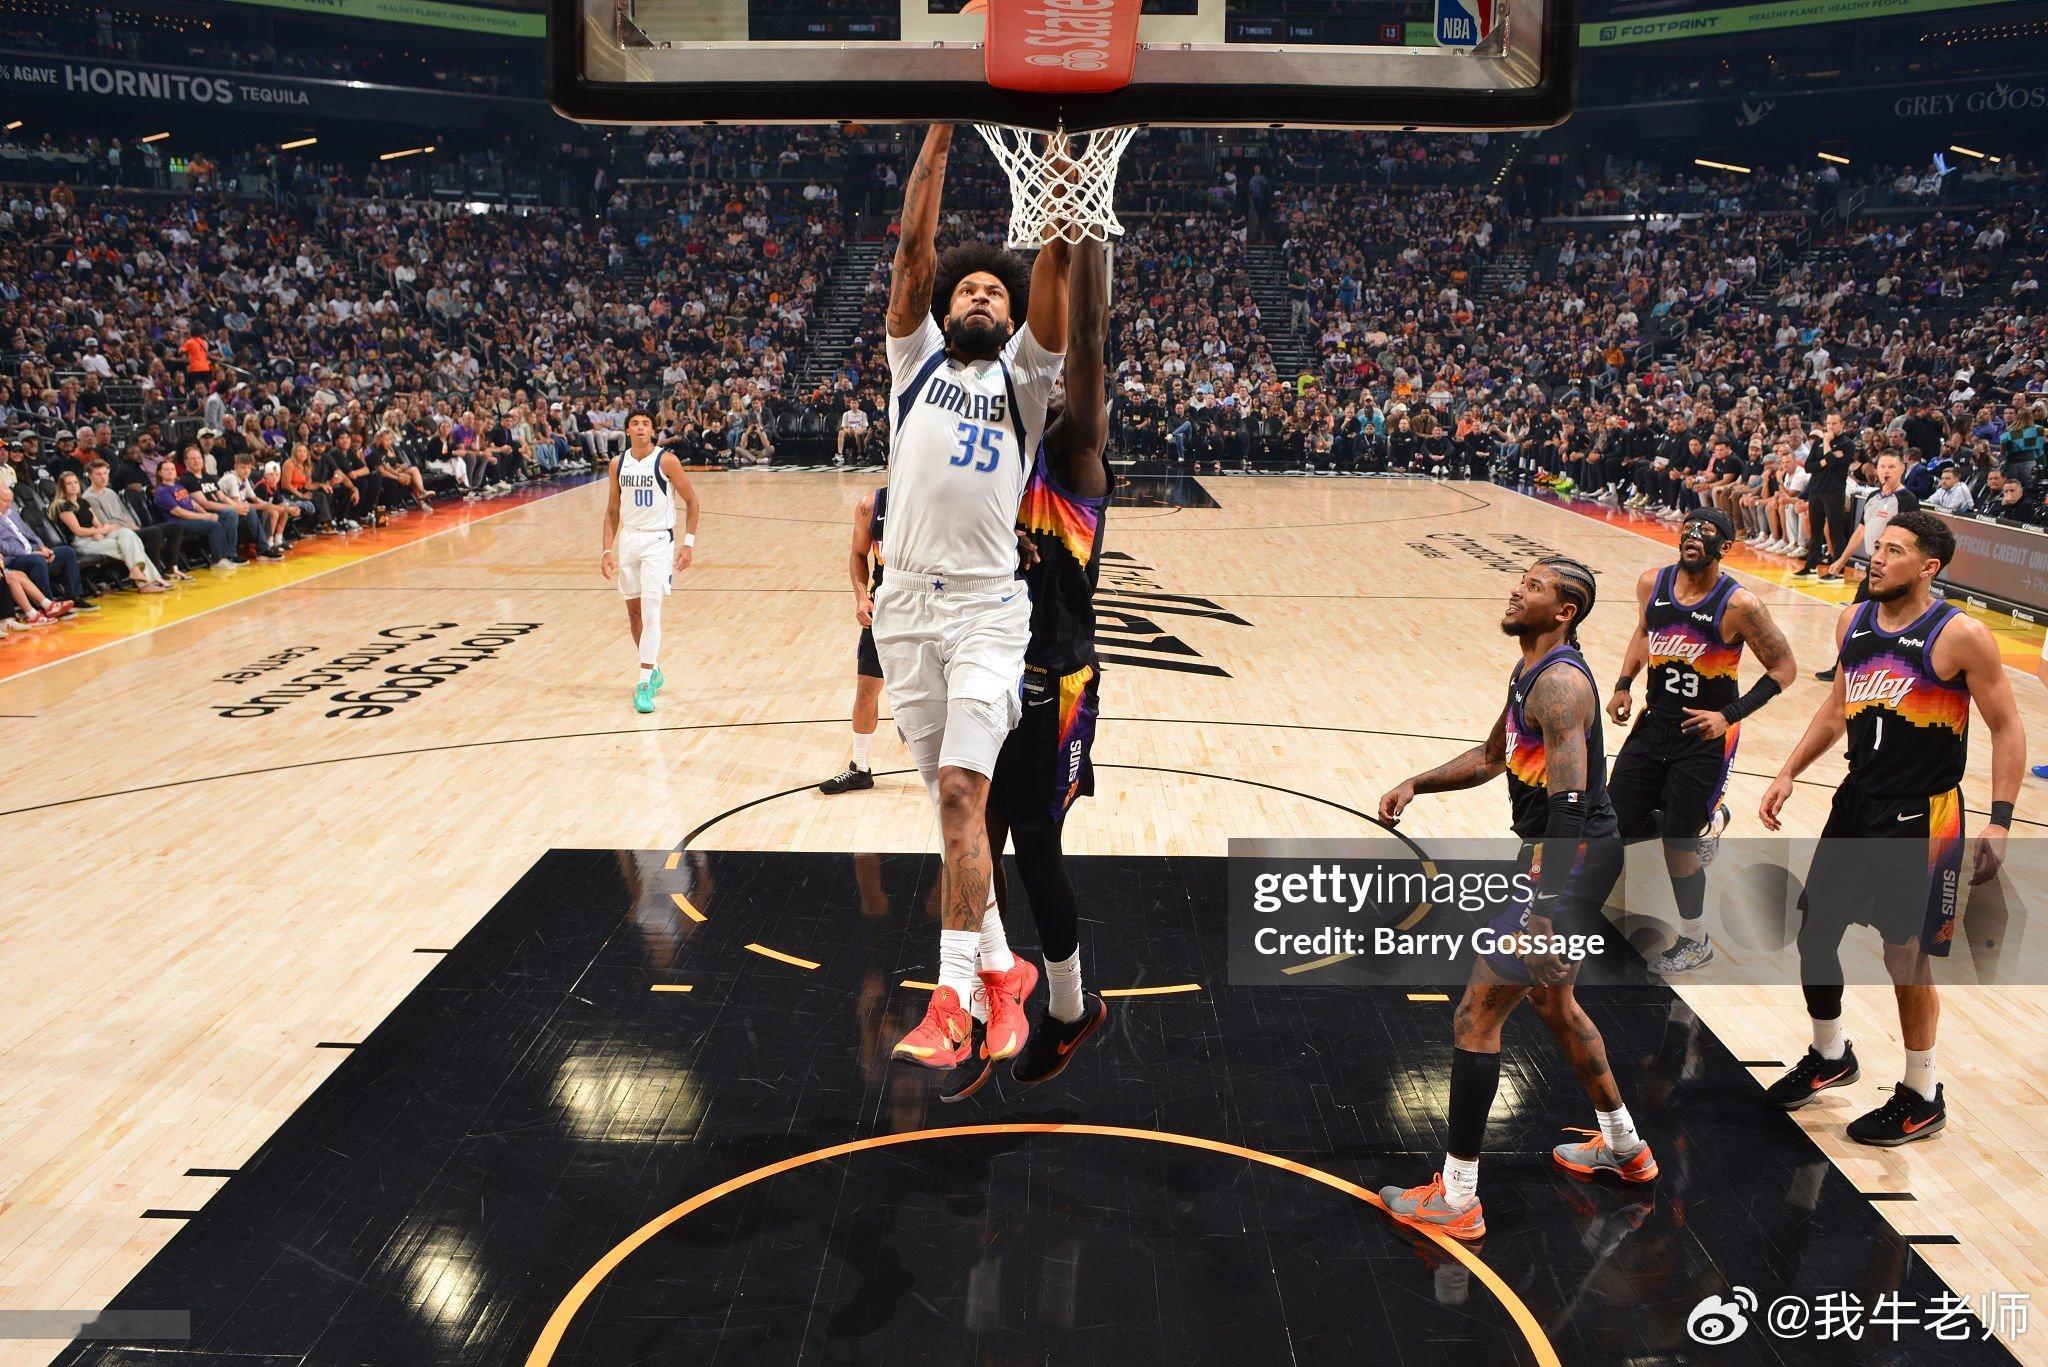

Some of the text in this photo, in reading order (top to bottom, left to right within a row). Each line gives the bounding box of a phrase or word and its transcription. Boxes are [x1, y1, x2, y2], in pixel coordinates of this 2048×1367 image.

[377, 3, 415, 15] HEALTHY
[449, 12, 486, 23] HEALTHY
[1621, 16, 1719, 37] FOOTPRINT
[1748, 11, 1788, 22] HEALTHY
[1827, 2, 1869, 13] HEALTHY
[1443, 18, 1471, 39] NBA
[14, 66, 58, 84] AGAVE
[65, 65, 233, 104] HORNITOS
[240, 86, 309, 105] TEQUILA
[1894, 87, 2048, 118] GREY GOOS
[925, 377, 1006, 422] DALLAS
[949, 422, 1004, 473] 35
[620, 475, 653, 487] DALLAS
[634, 489, 653, 507] 00
[1992, 543, 2028, 566] CREDIT
[2029, 550, 2048, 573] UNI
[1691, 611, 1713, 622] PayPal
[1898, 636, 1925, 648] PayPal
[212, 642, 411, 718] matchup
[213, 645, 320, 684] center
[325, 622, 545, 719] mortgage
[1665, 667, 1699, 698] 23
[1873, 716, 1883, 751] 1
[1941, 869, 1956, 916] SUNS
